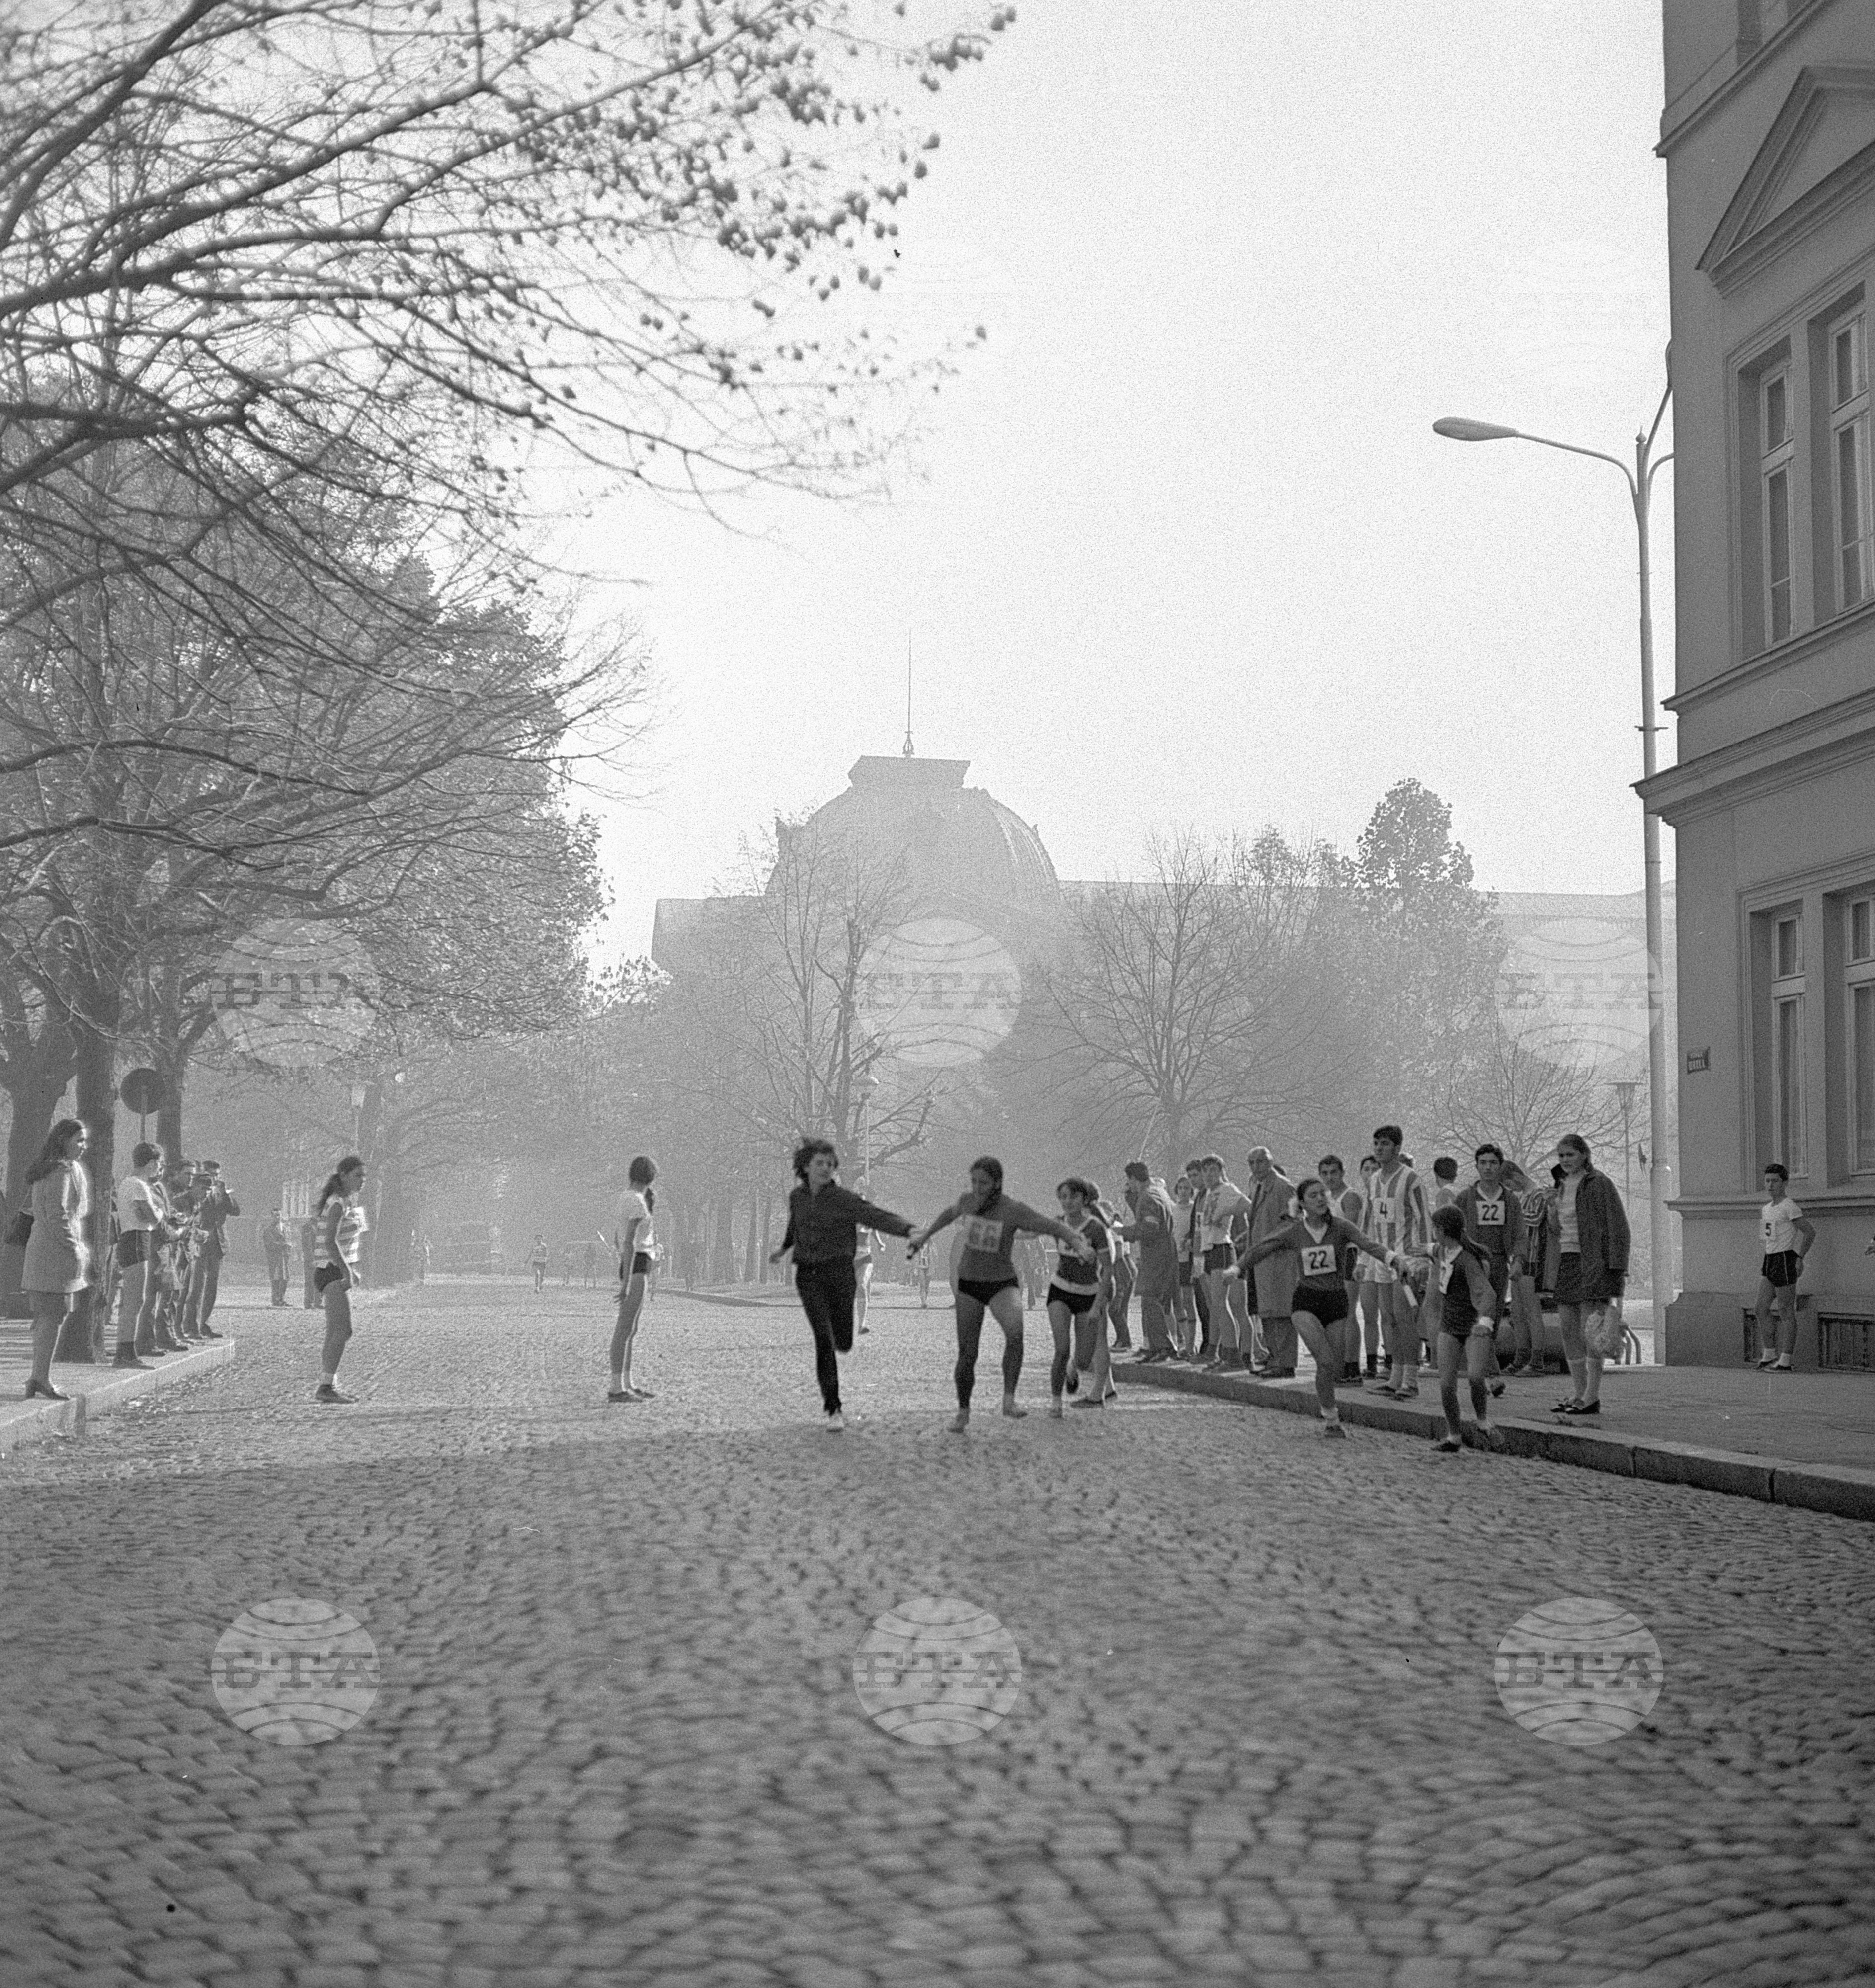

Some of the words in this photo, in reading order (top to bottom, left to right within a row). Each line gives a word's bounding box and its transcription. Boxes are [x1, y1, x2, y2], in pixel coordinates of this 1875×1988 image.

[1380, 1202, 1388, 1219] 4
[1482, 1204, 1499, 1221] 22
[1765, 1222, 1772, 1237] 5
[1308, 1250, 1329, 1270] 22
